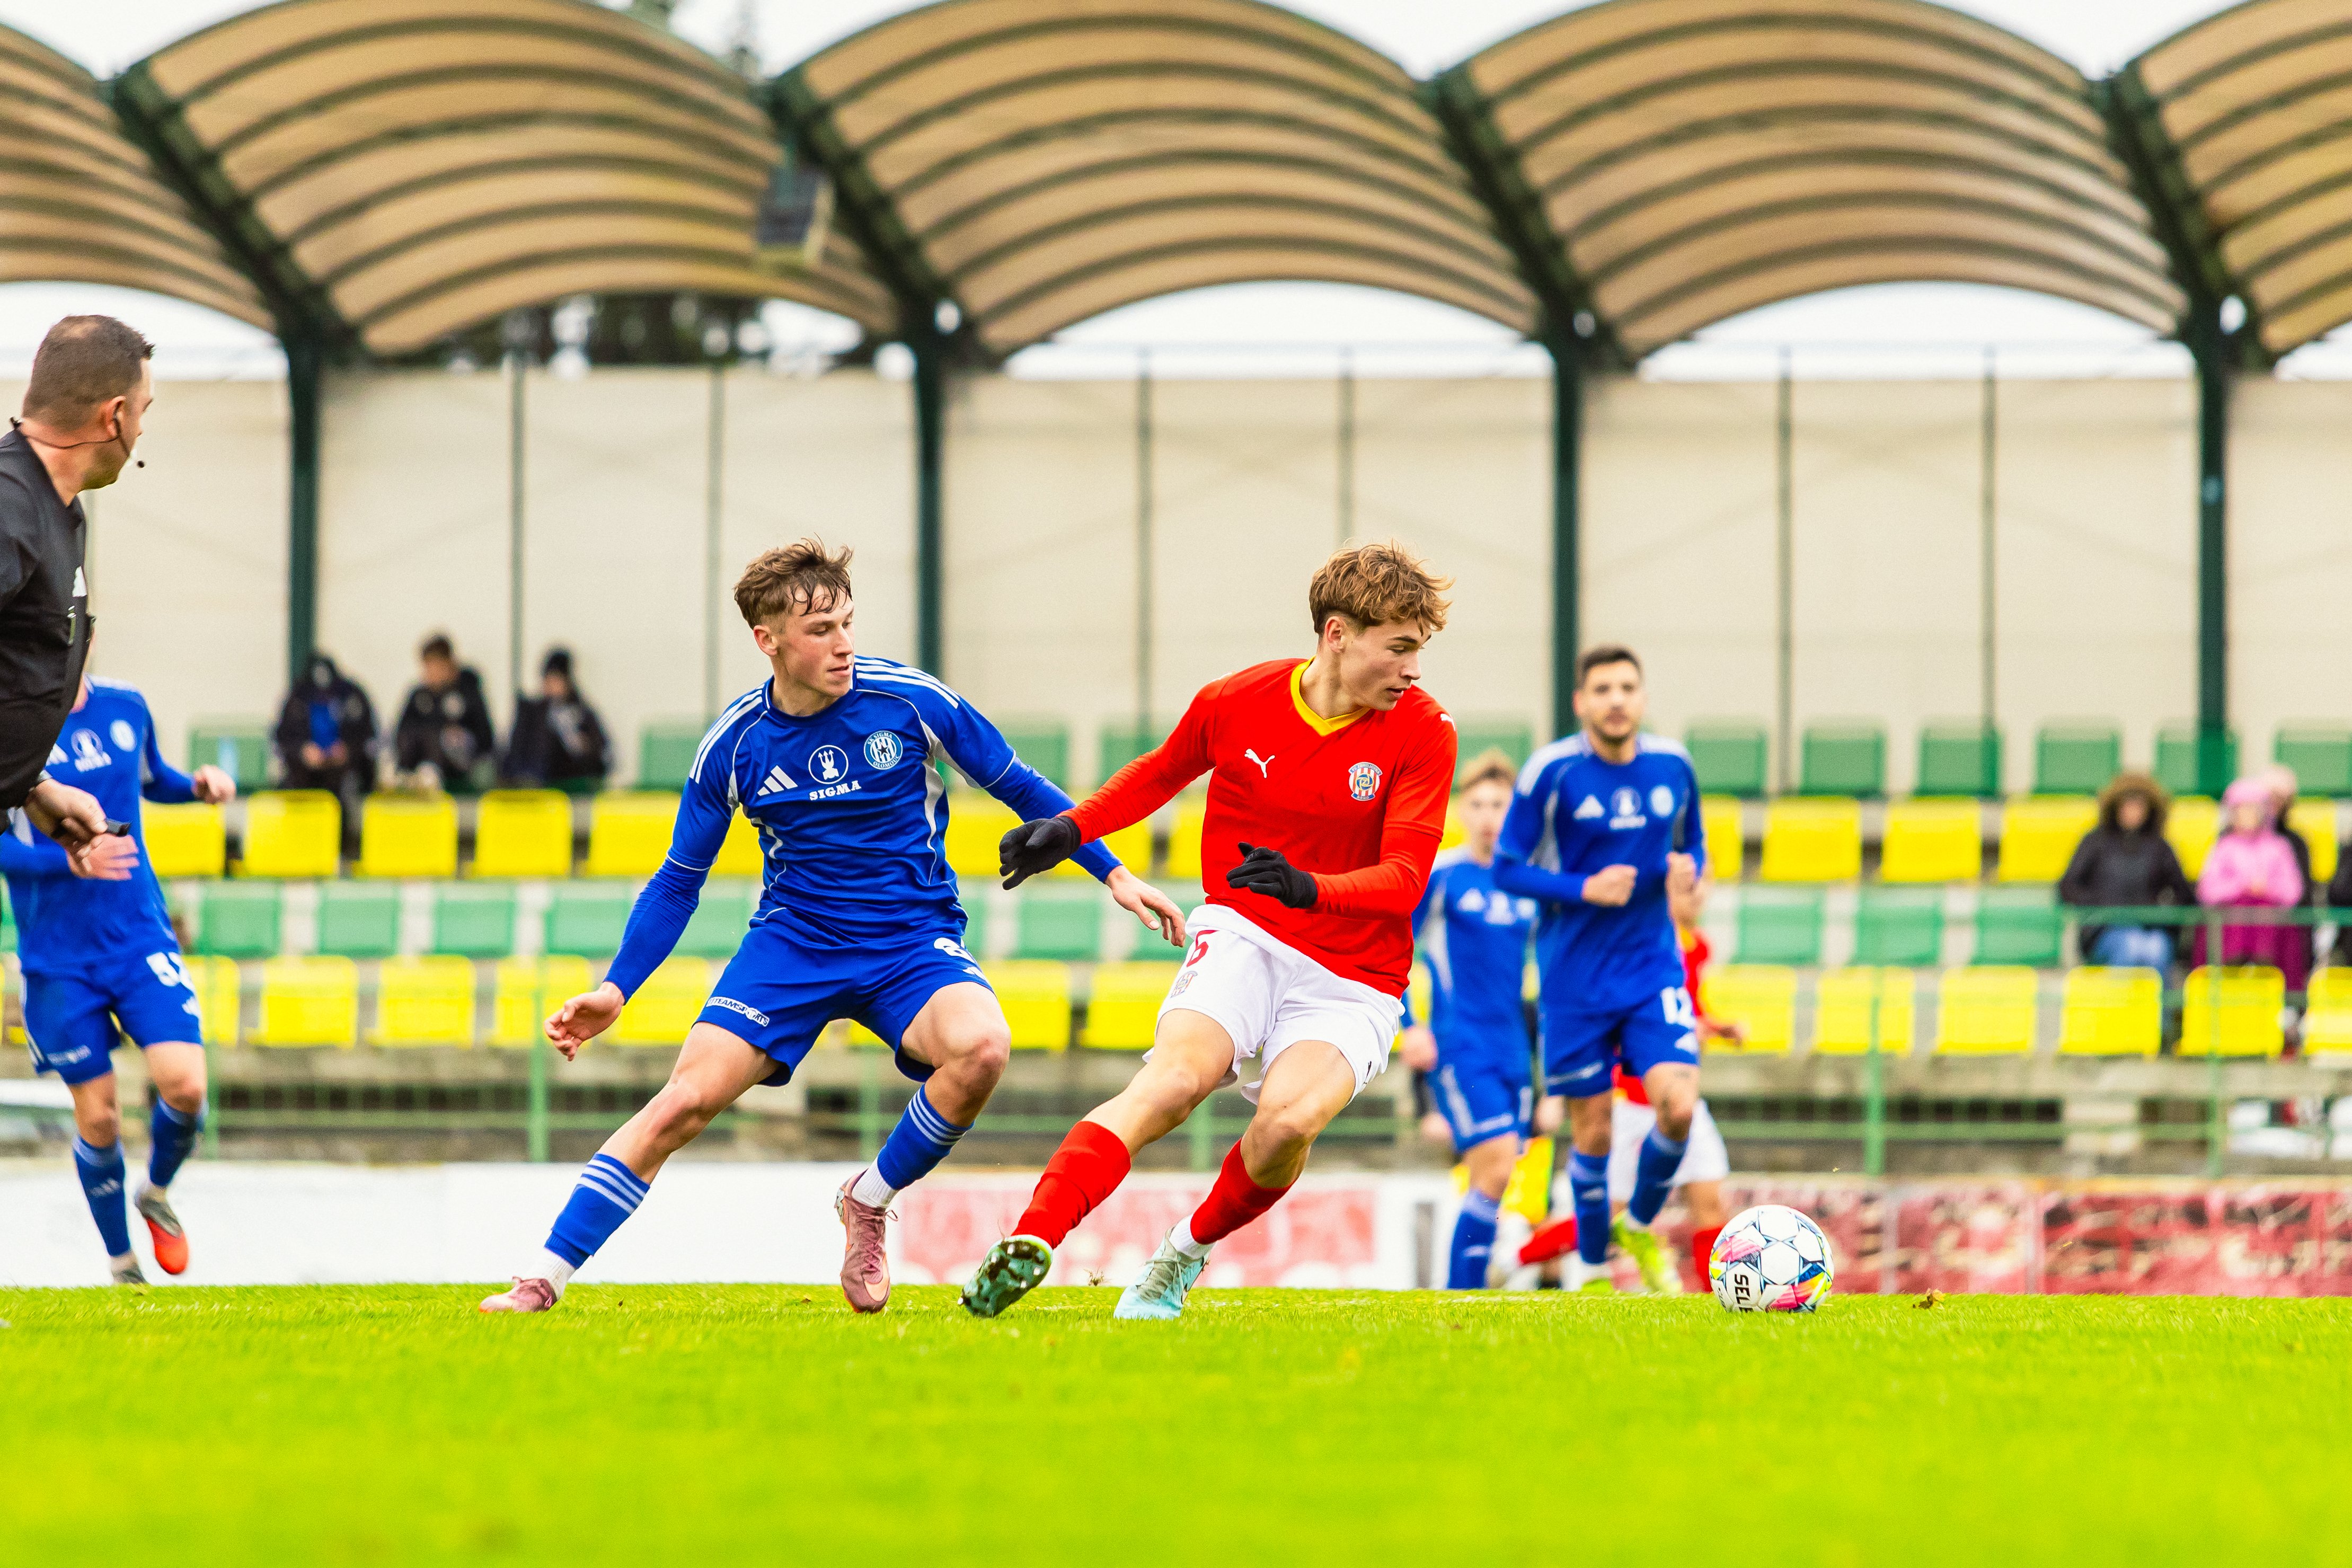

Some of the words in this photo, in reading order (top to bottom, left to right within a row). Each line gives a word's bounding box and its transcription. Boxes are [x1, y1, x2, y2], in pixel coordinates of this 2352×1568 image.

[867, 737, 874, 745] SK
[873, 754, 900, 768] OLOMOUC
[809, 780, 862, 801] SIGMA
